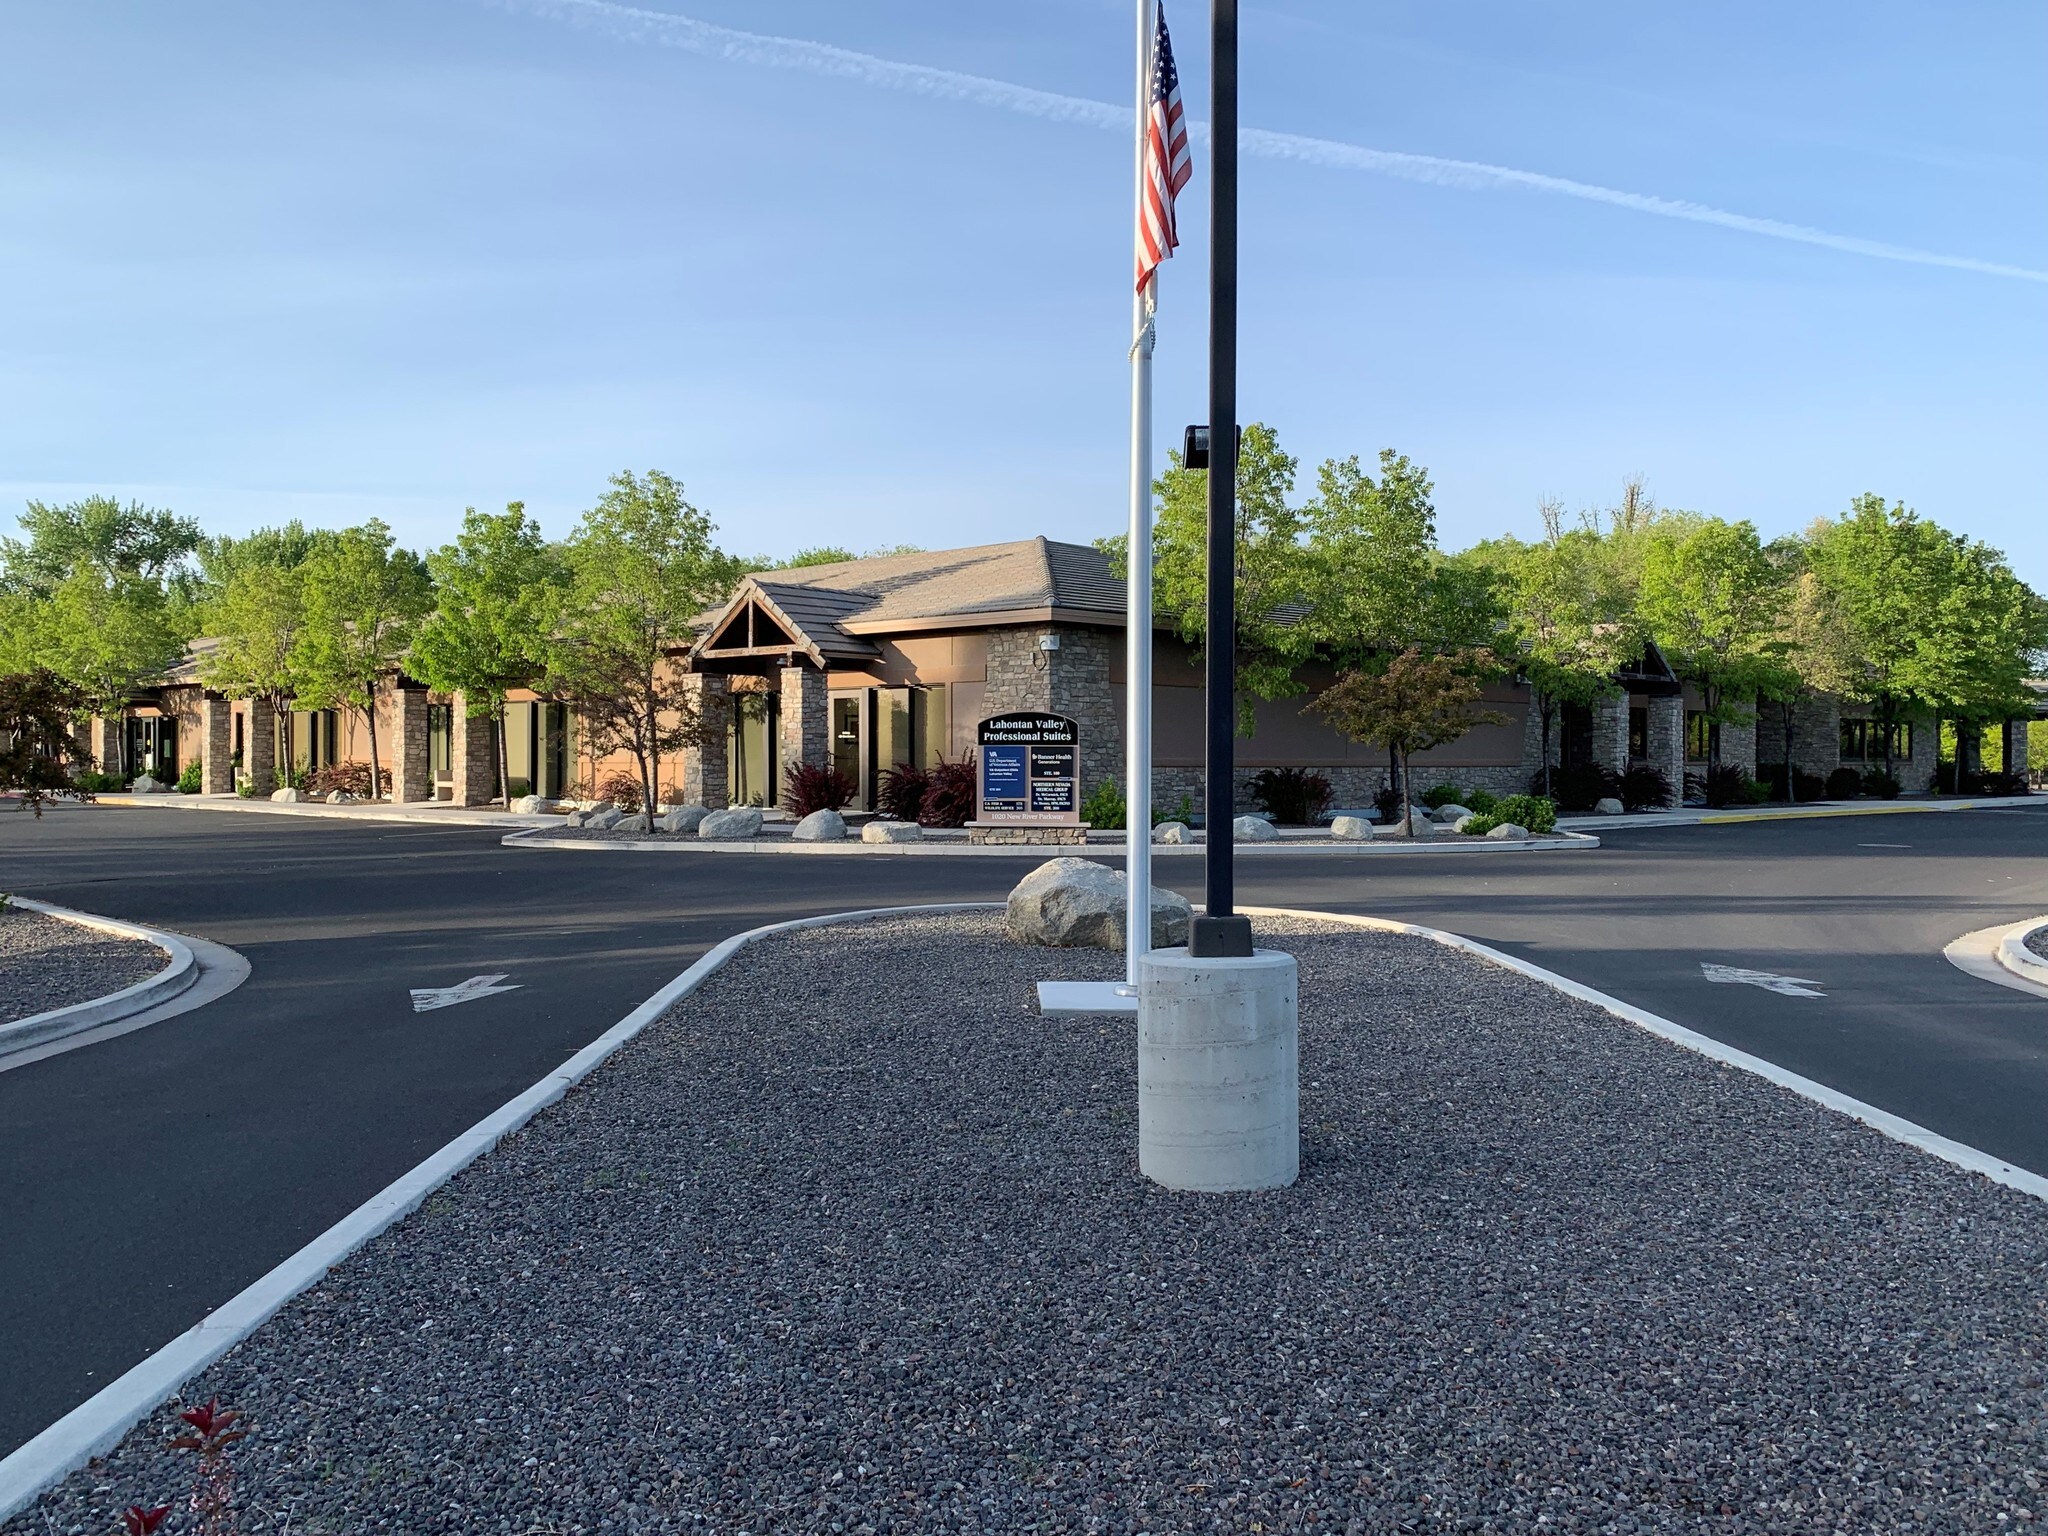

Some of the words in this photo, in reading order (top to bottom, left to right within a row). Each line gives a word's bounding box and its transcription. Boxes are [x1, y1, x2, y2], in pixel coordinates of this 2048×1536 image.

[990, 720, 1032, 729] Lahontan
[1036, 720, 1065, 730] Valley
[984, 732, 1040, 741] Professional
[1043, 732, 1072, 741] Suites
[1039, 813, 1064, 821] Parkway
